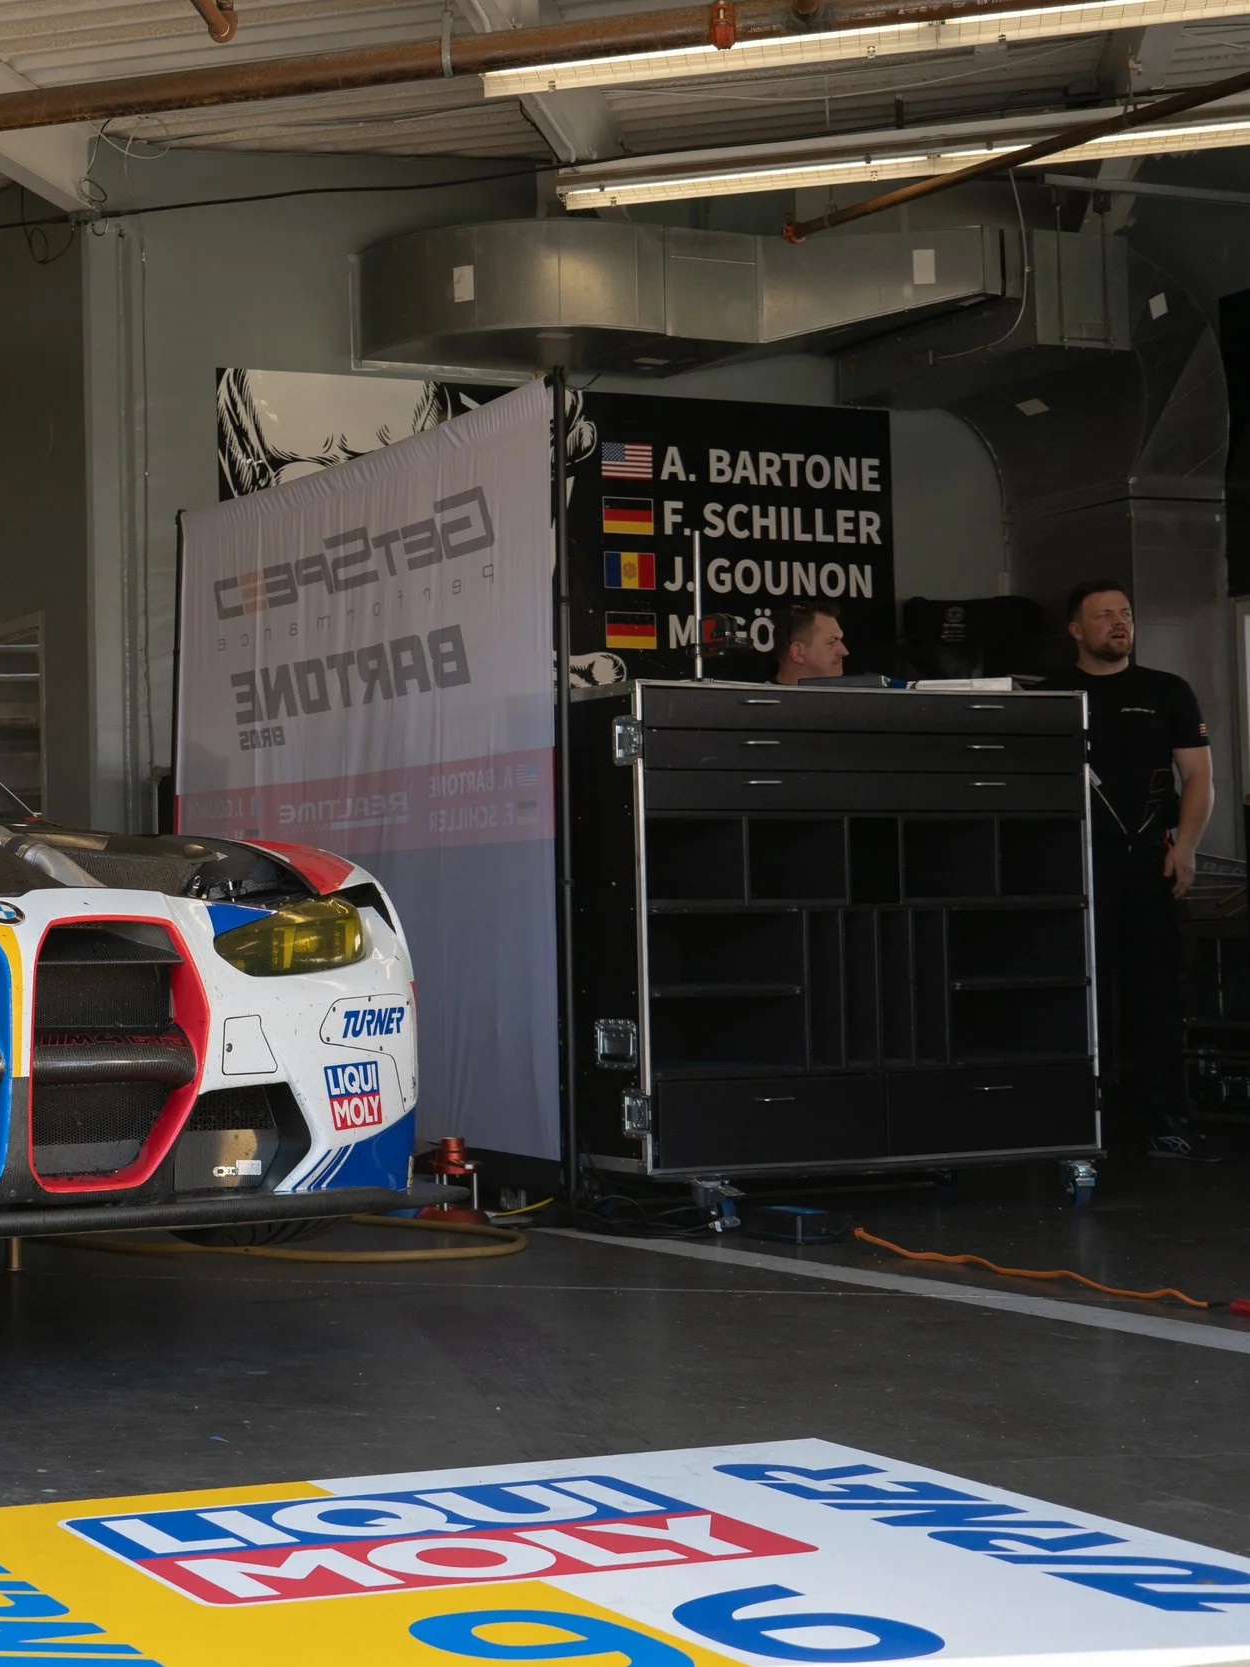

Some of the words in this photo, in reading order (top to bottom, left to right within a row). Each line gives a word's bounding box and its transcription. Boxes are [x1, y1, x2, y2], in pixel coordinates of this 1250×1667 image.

[661, 446, 696, 482] A.
[709, 449, 881, 491] BARTONE
[663, 501, 691, 536] F.
[703, 503, 882, 545] SCHILLER
[664, 557, 694, 592] J.
[707, 558, 872, 599] GOUNON
[342, 1007, 405, 1038] TURNER
[327, 1064, 379, 1095] LIQUI
[332, 1095, 380, 1128] MOLY
[100, 1478, 668, 1555] LIQUI
[173, 1514, 753, 1600] MOLY
